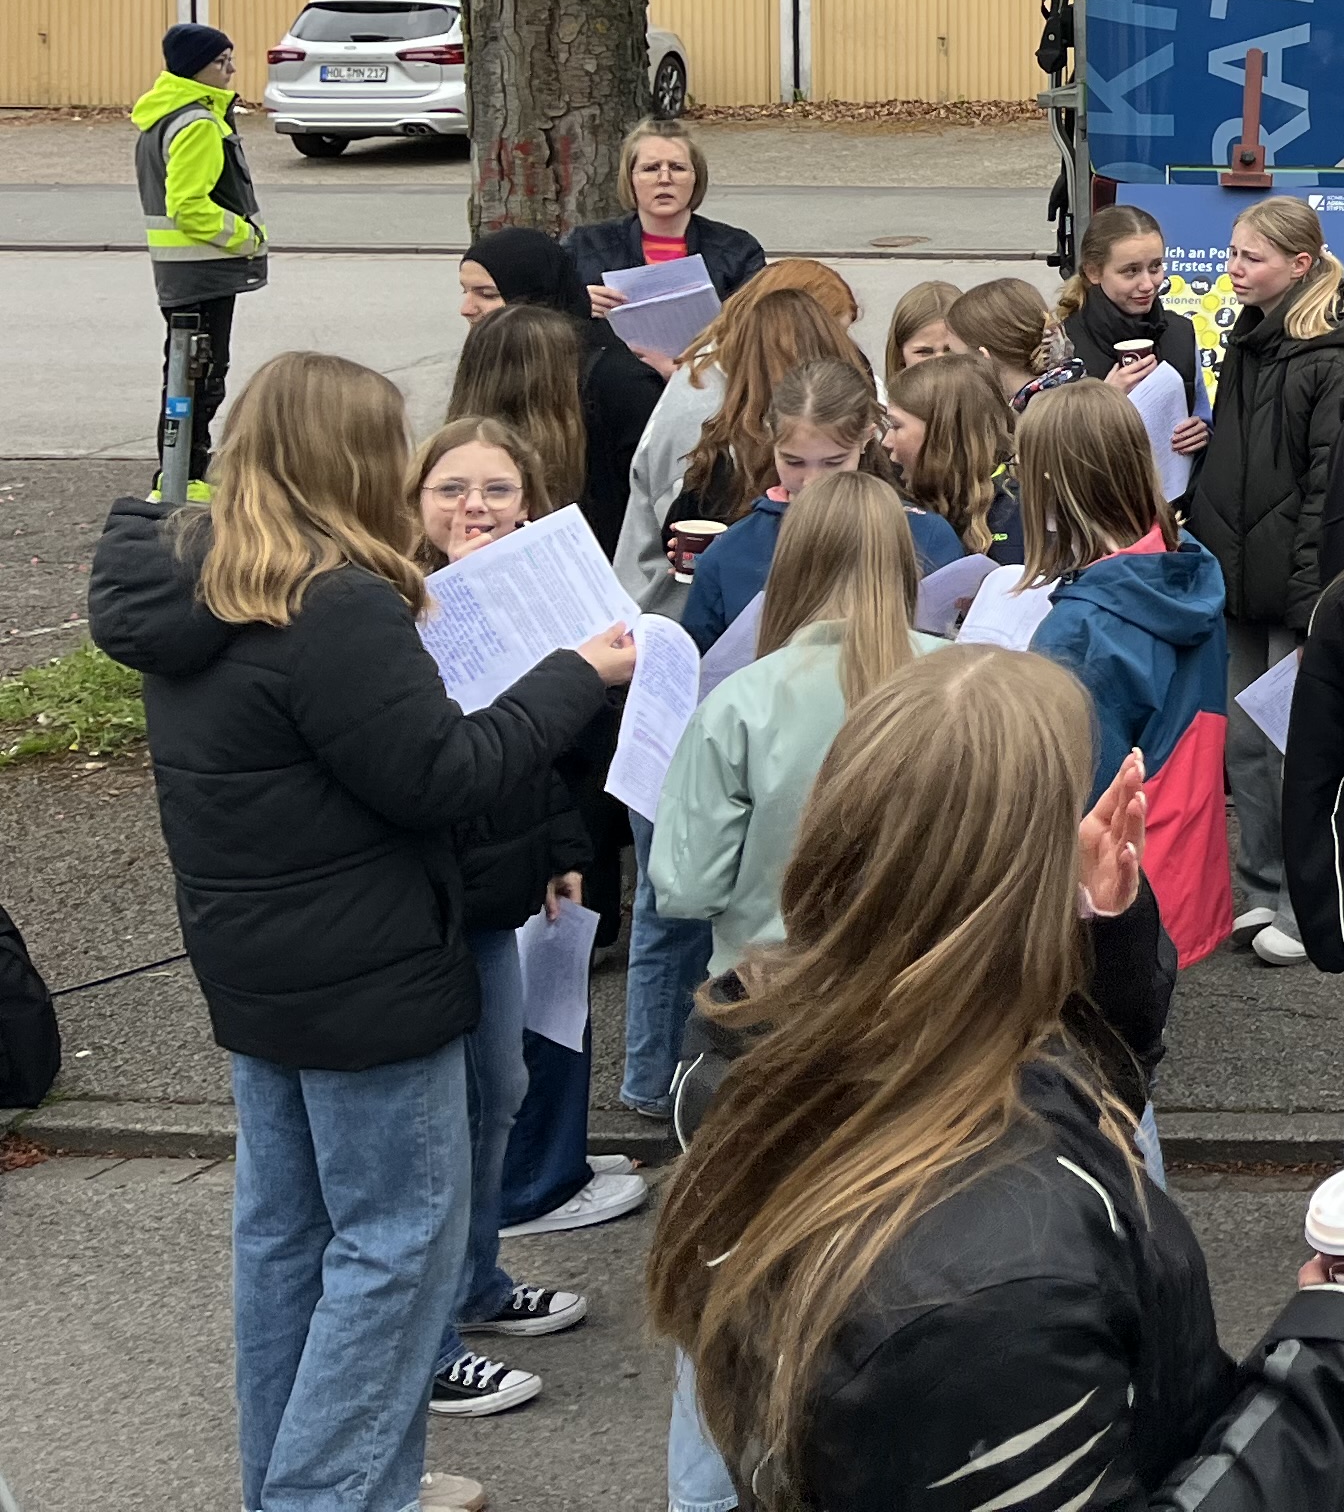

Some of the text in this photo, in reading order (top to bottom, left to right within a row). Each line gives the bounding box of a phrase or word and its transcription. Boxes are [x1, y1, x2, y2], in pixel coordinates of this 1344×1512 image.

[1188, 249, 1206, 259] an
[1209, 247, 1231, 260] Pol
[1171, 260, 1213, 273] Erstes
